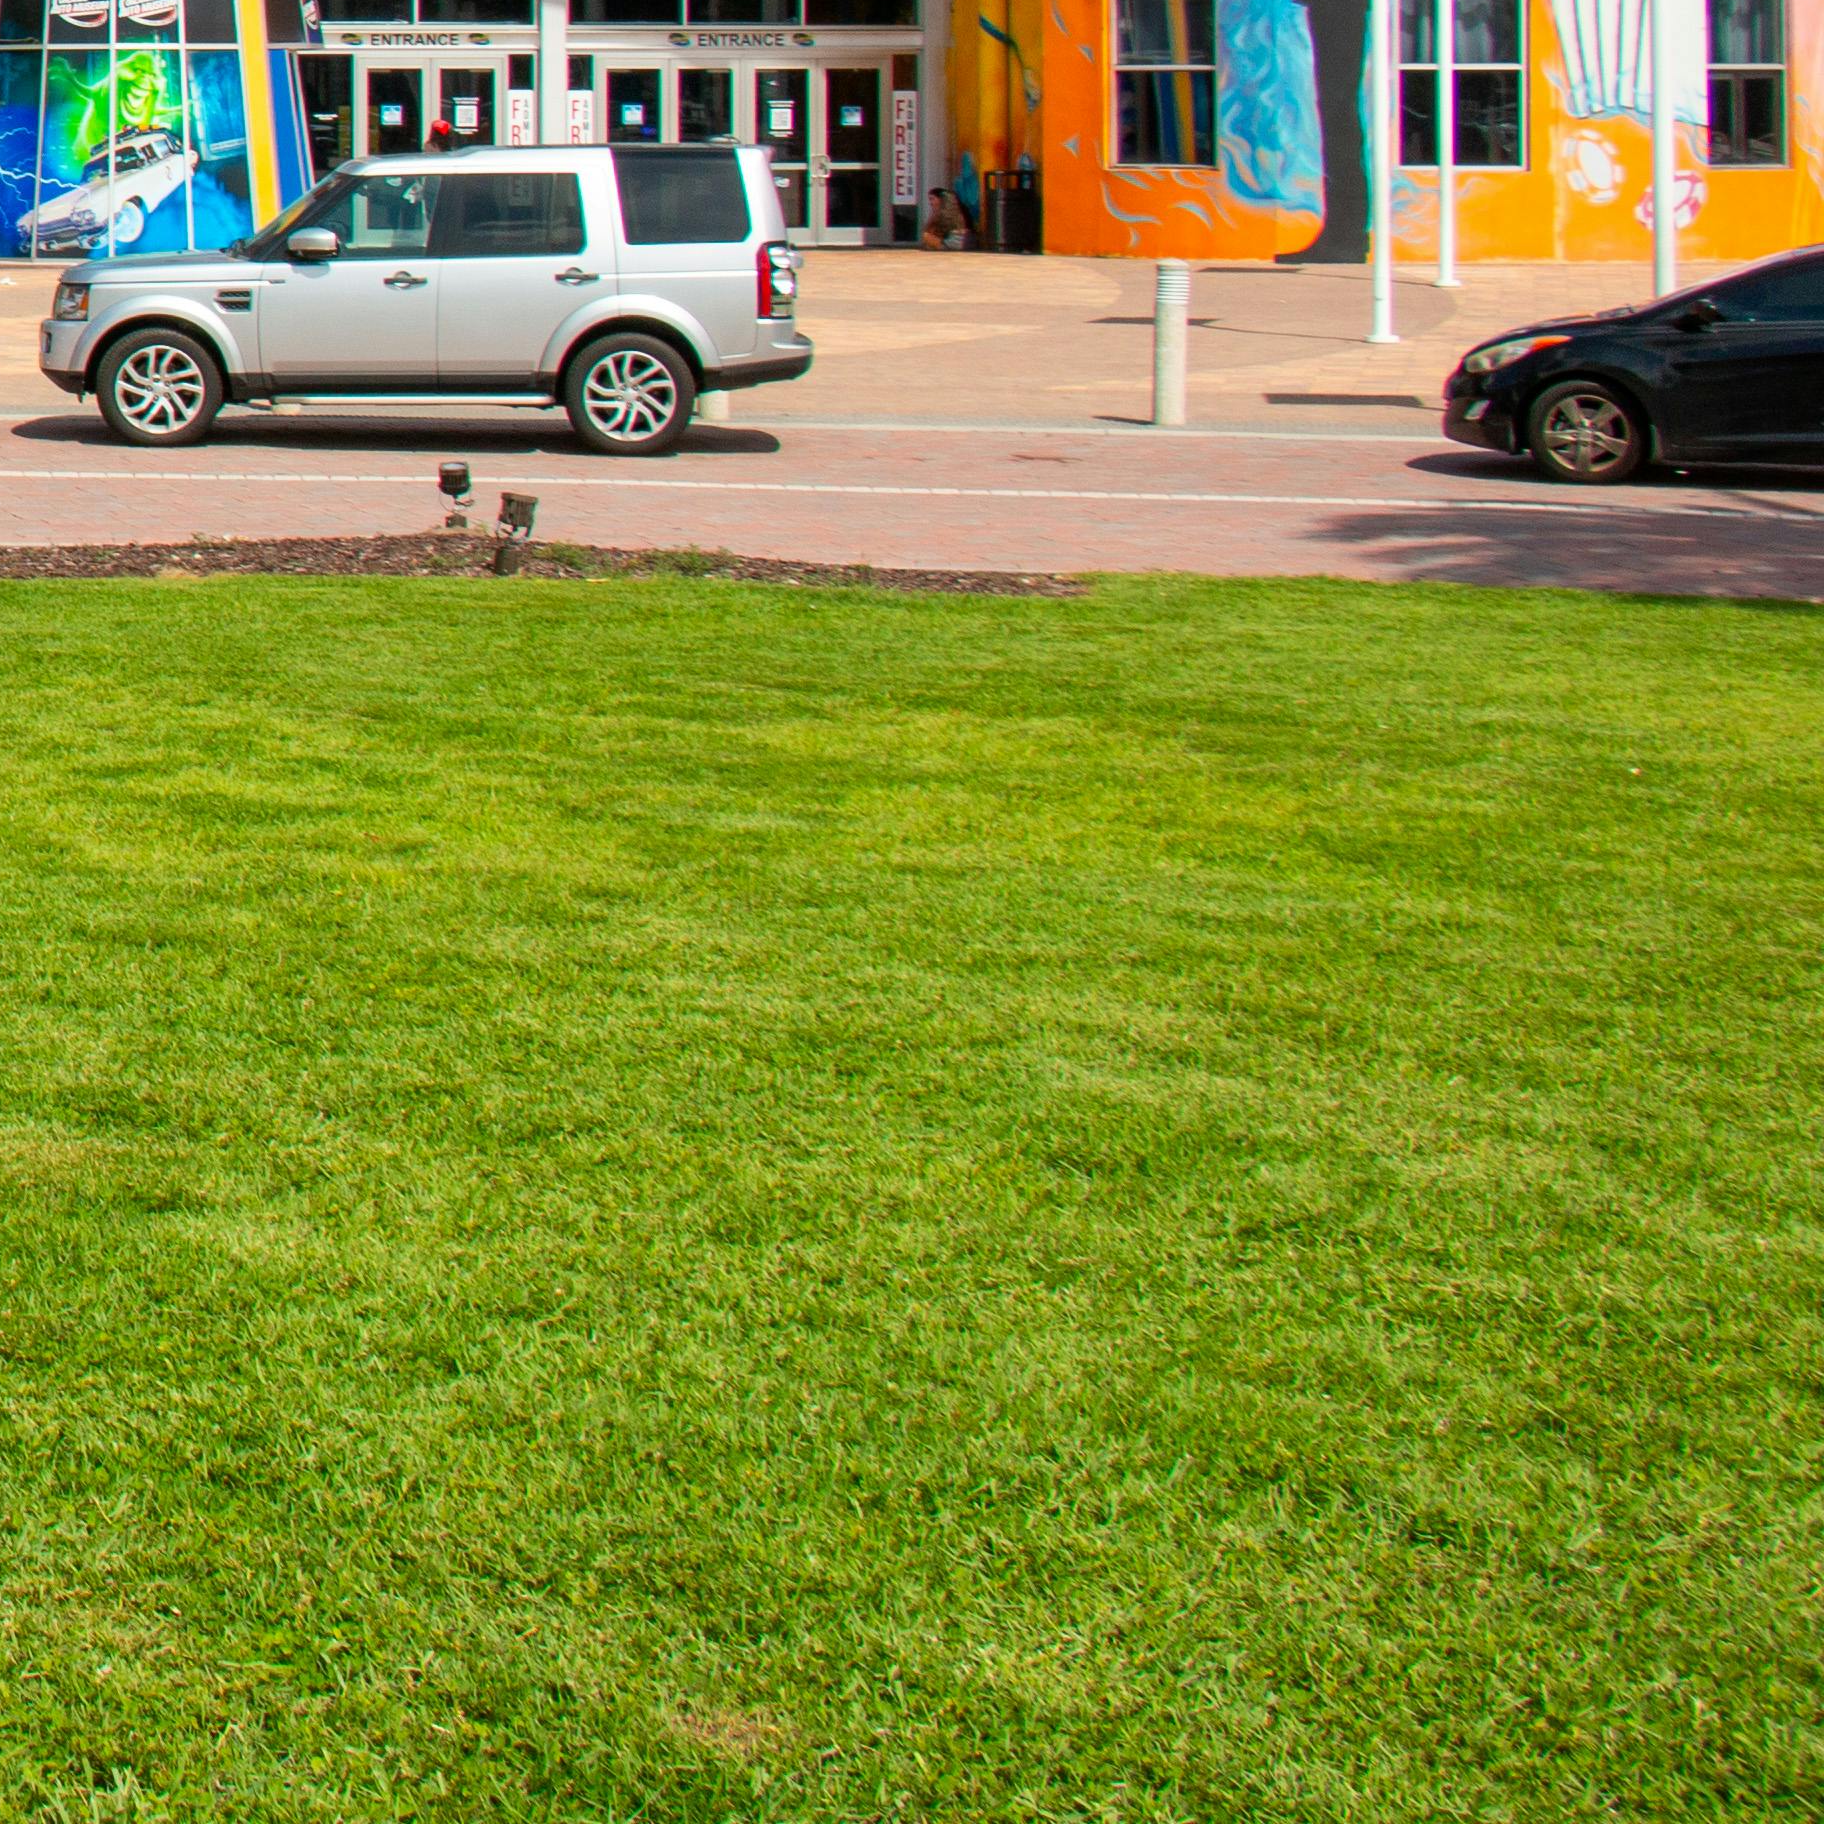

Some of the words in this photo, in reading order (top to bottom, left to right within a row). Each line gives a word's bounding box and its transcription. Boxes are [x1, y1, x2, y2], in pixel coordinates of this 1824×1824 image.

[370, 33, 460, 46] ENTRANCE
[697, 33, 785, 46] ENTRANCE
[895, 99, 906, 196] FREE
